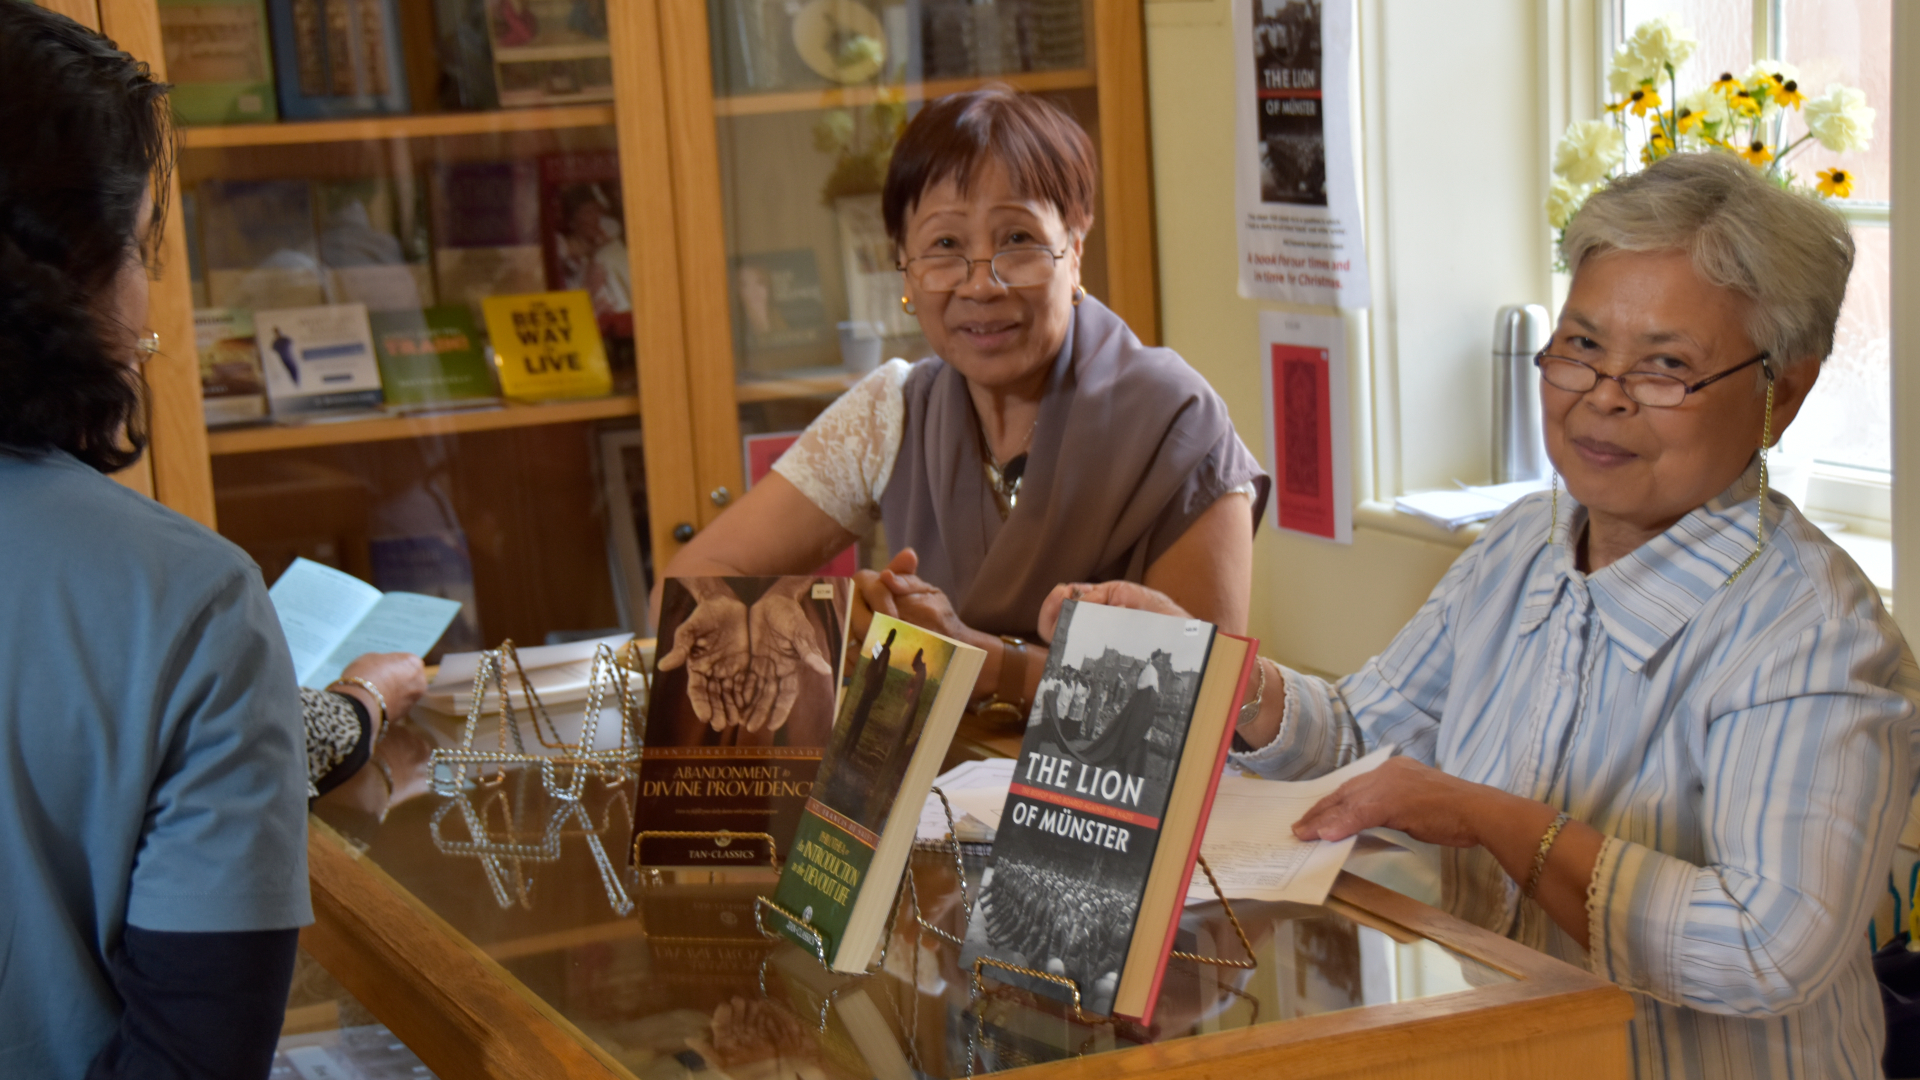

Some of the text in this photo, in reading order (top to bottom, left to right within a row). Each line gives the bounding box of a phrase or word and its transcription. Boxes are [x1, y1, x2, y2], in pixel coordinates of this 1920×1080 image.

[1263, 68, 1316, 89] THE LION
[1265, 99, 1280, 116] OF
[1254, 253, 1277, 266] book
[1308, 256, 1330, 270] times
[1331, 258, 1351, 272] and
[1263, 271, 1284, 285] time
[511, 308, 569, 328] BEST
[517, 327, 571, 345] WAY
[523, 352, 584, 375] LIVE
[673, 766, 791, 779] ABANDONMENT to
[1025, 751, 1145, 807] THE LION
[643, 780, 703, 797] DIVINE
[822, 808, 847, 828] FRANCIS
[1012, 801, 1130, 853] OF MÜNSTER
[802, 840, 861, 888] INTRODUCTION
[802, 864, 838, 897] DEVOUT
[833, 883, 851, 907] LIFE
